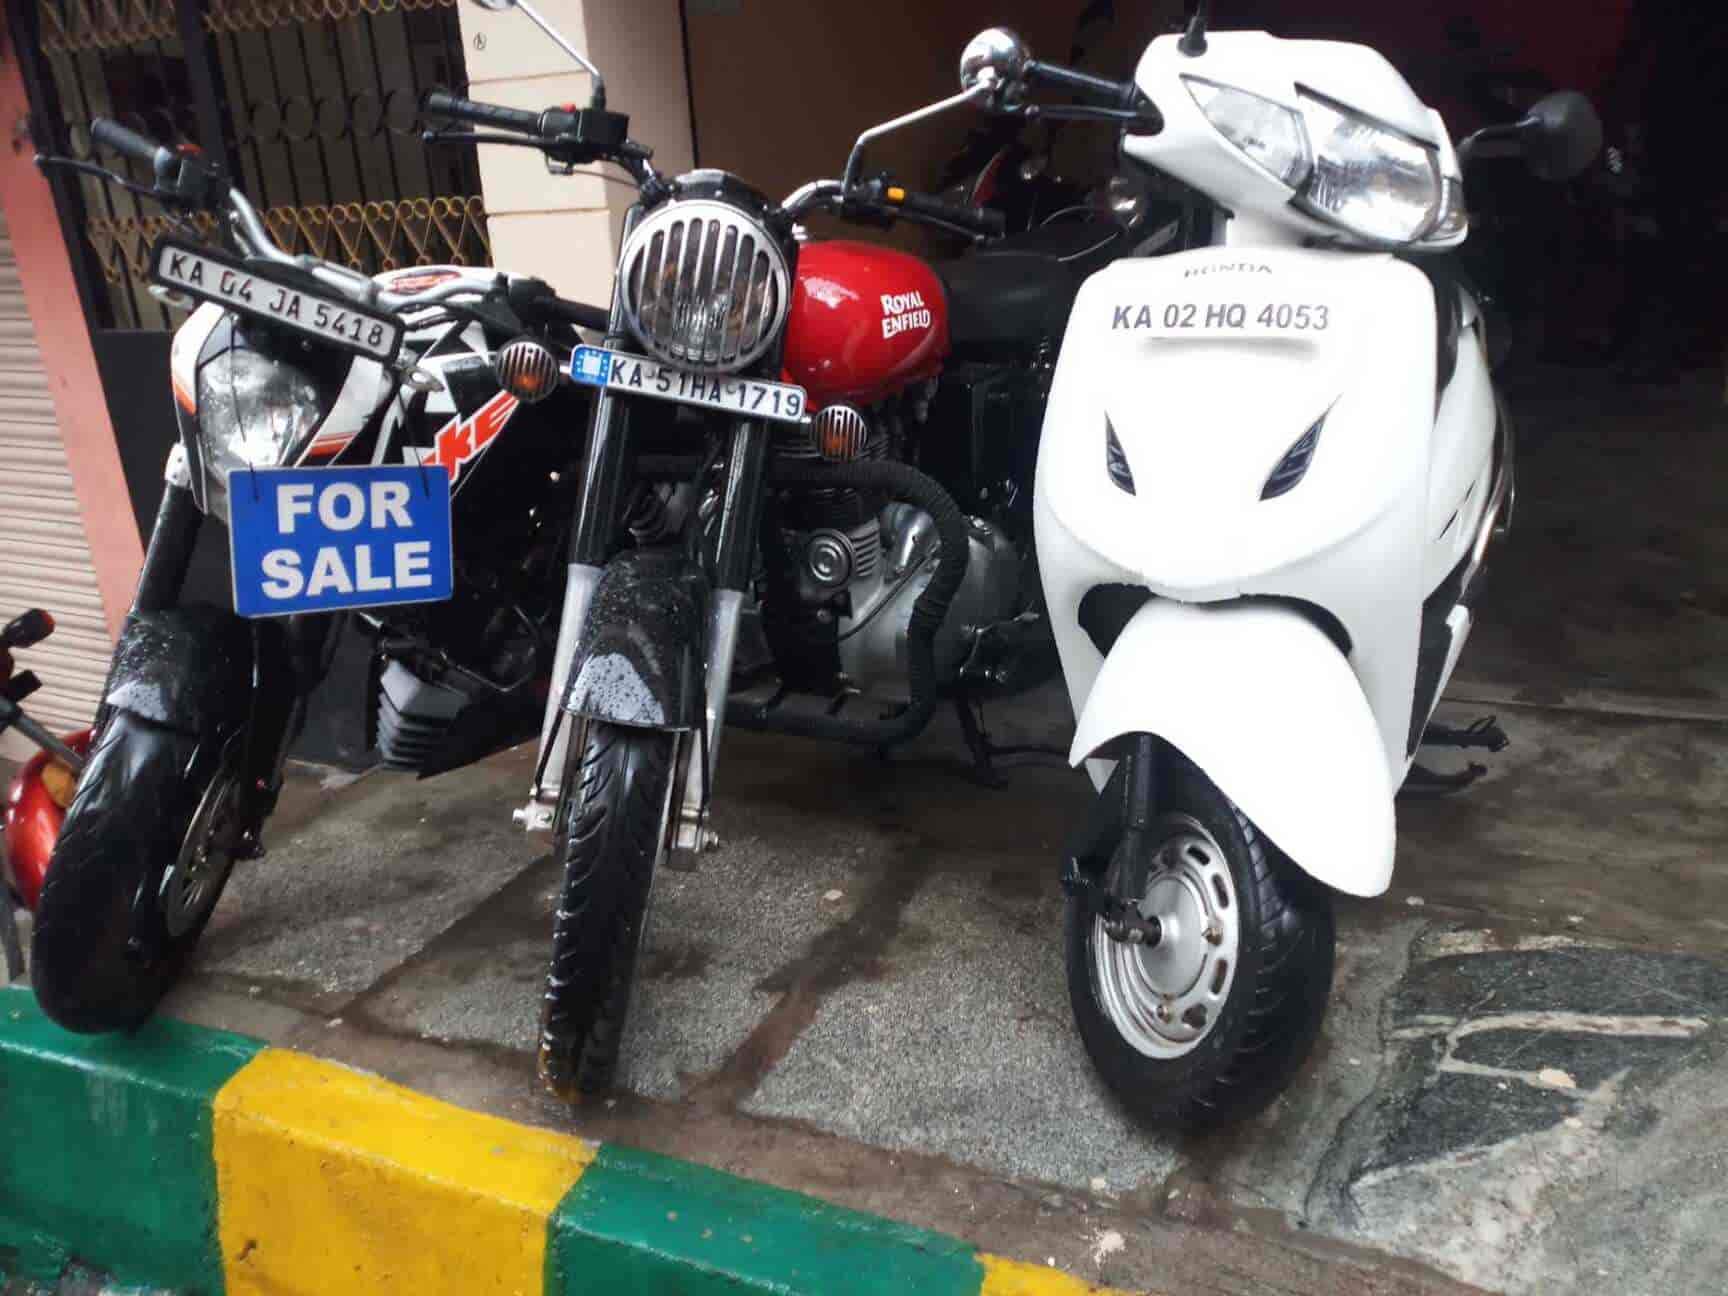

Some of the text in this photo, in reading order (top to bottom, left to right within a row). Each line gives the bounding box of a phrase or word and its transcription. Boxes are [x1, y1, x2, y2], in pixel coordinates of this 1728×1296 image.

[168, 252, 204, 287] KA
[268, 288, 301, 321] JA
[313, 303, 386, 348] 5418
[880, 290, 925, 316] ROYAL
[1111, 303, 1330, 331] KA 02 HQ 4053
[881, 309, 931, 340] ENFIELD
[276, 480, 414, 534] FOR
[260, 540, 433, 600] SALE
